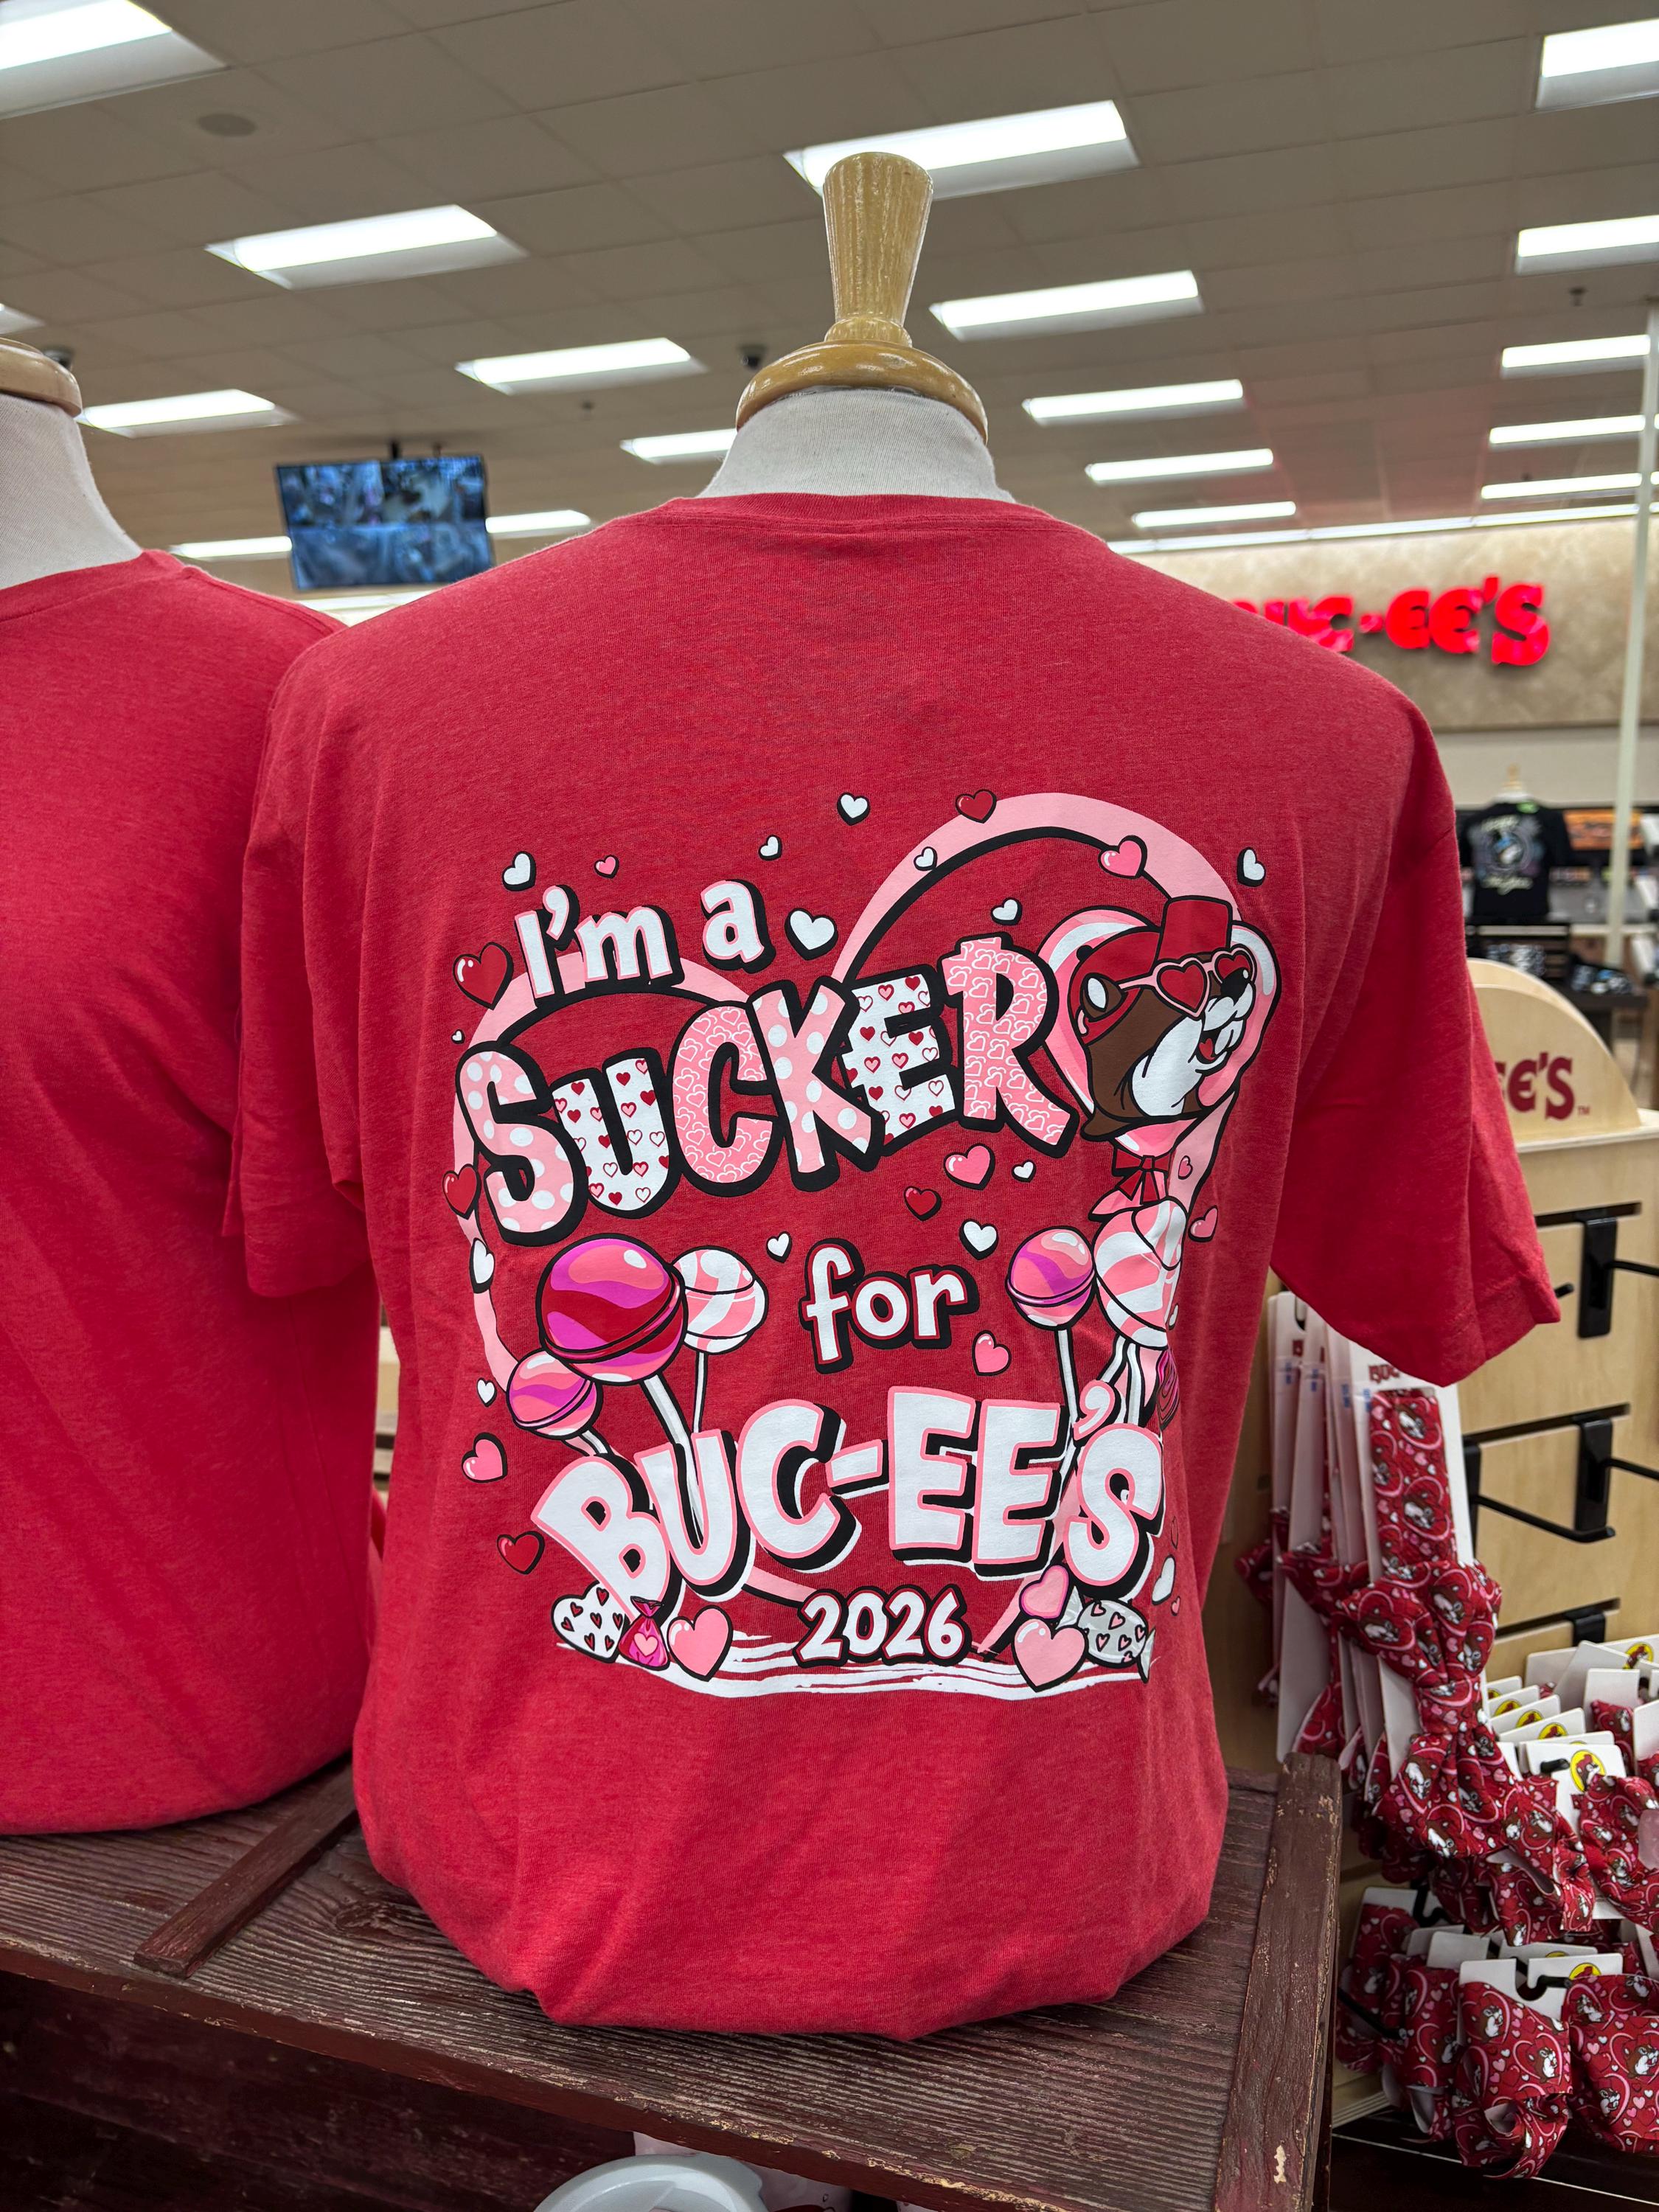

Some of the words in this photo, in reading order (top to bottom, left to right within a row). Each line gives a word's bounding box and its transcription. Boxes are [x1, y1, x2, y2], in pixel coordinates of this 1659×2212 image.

[1231, 574, 1549, 666] UC-EE'S
[515, 885, 677, 1000] I'm
[700, 880, 768, 965] a
[459, 935, 1075, 1237] SUCKER
[1495, 1051, 1575, 1121] E'S
[800, 1242, 972, 1367] for
[531, 1380, 1162, 1622] BUC-EE'S
[796, 1587, 967, 1664] 2026
